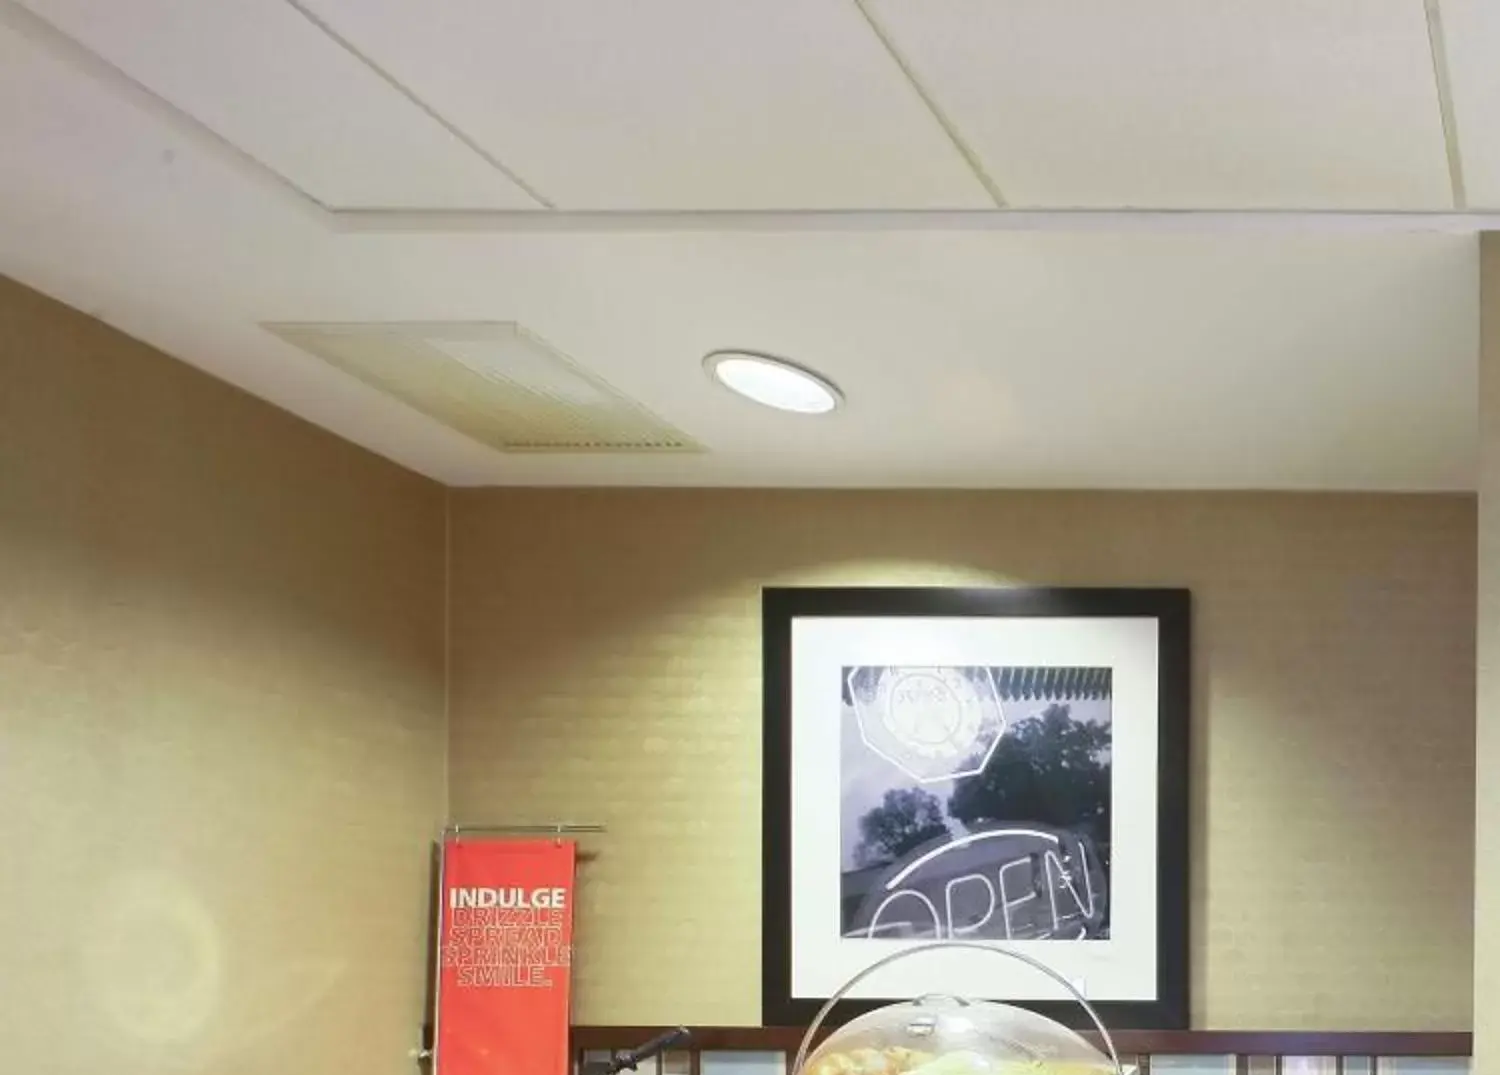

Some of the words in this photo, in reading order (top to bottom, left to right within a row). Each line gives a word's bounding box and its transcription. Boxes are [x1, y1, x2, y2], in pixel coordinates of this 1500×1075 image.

[449, 887, 567, 909] INDULGE
[869, 842, 1095, 939] OPEN
[452, 907, 562, 929] DRIZZLE
[449, 926, 562, 948] SPREAD
[444, 945, 571, 968] SPRINKLE
[457, 965, 553, 987] SMILE.
